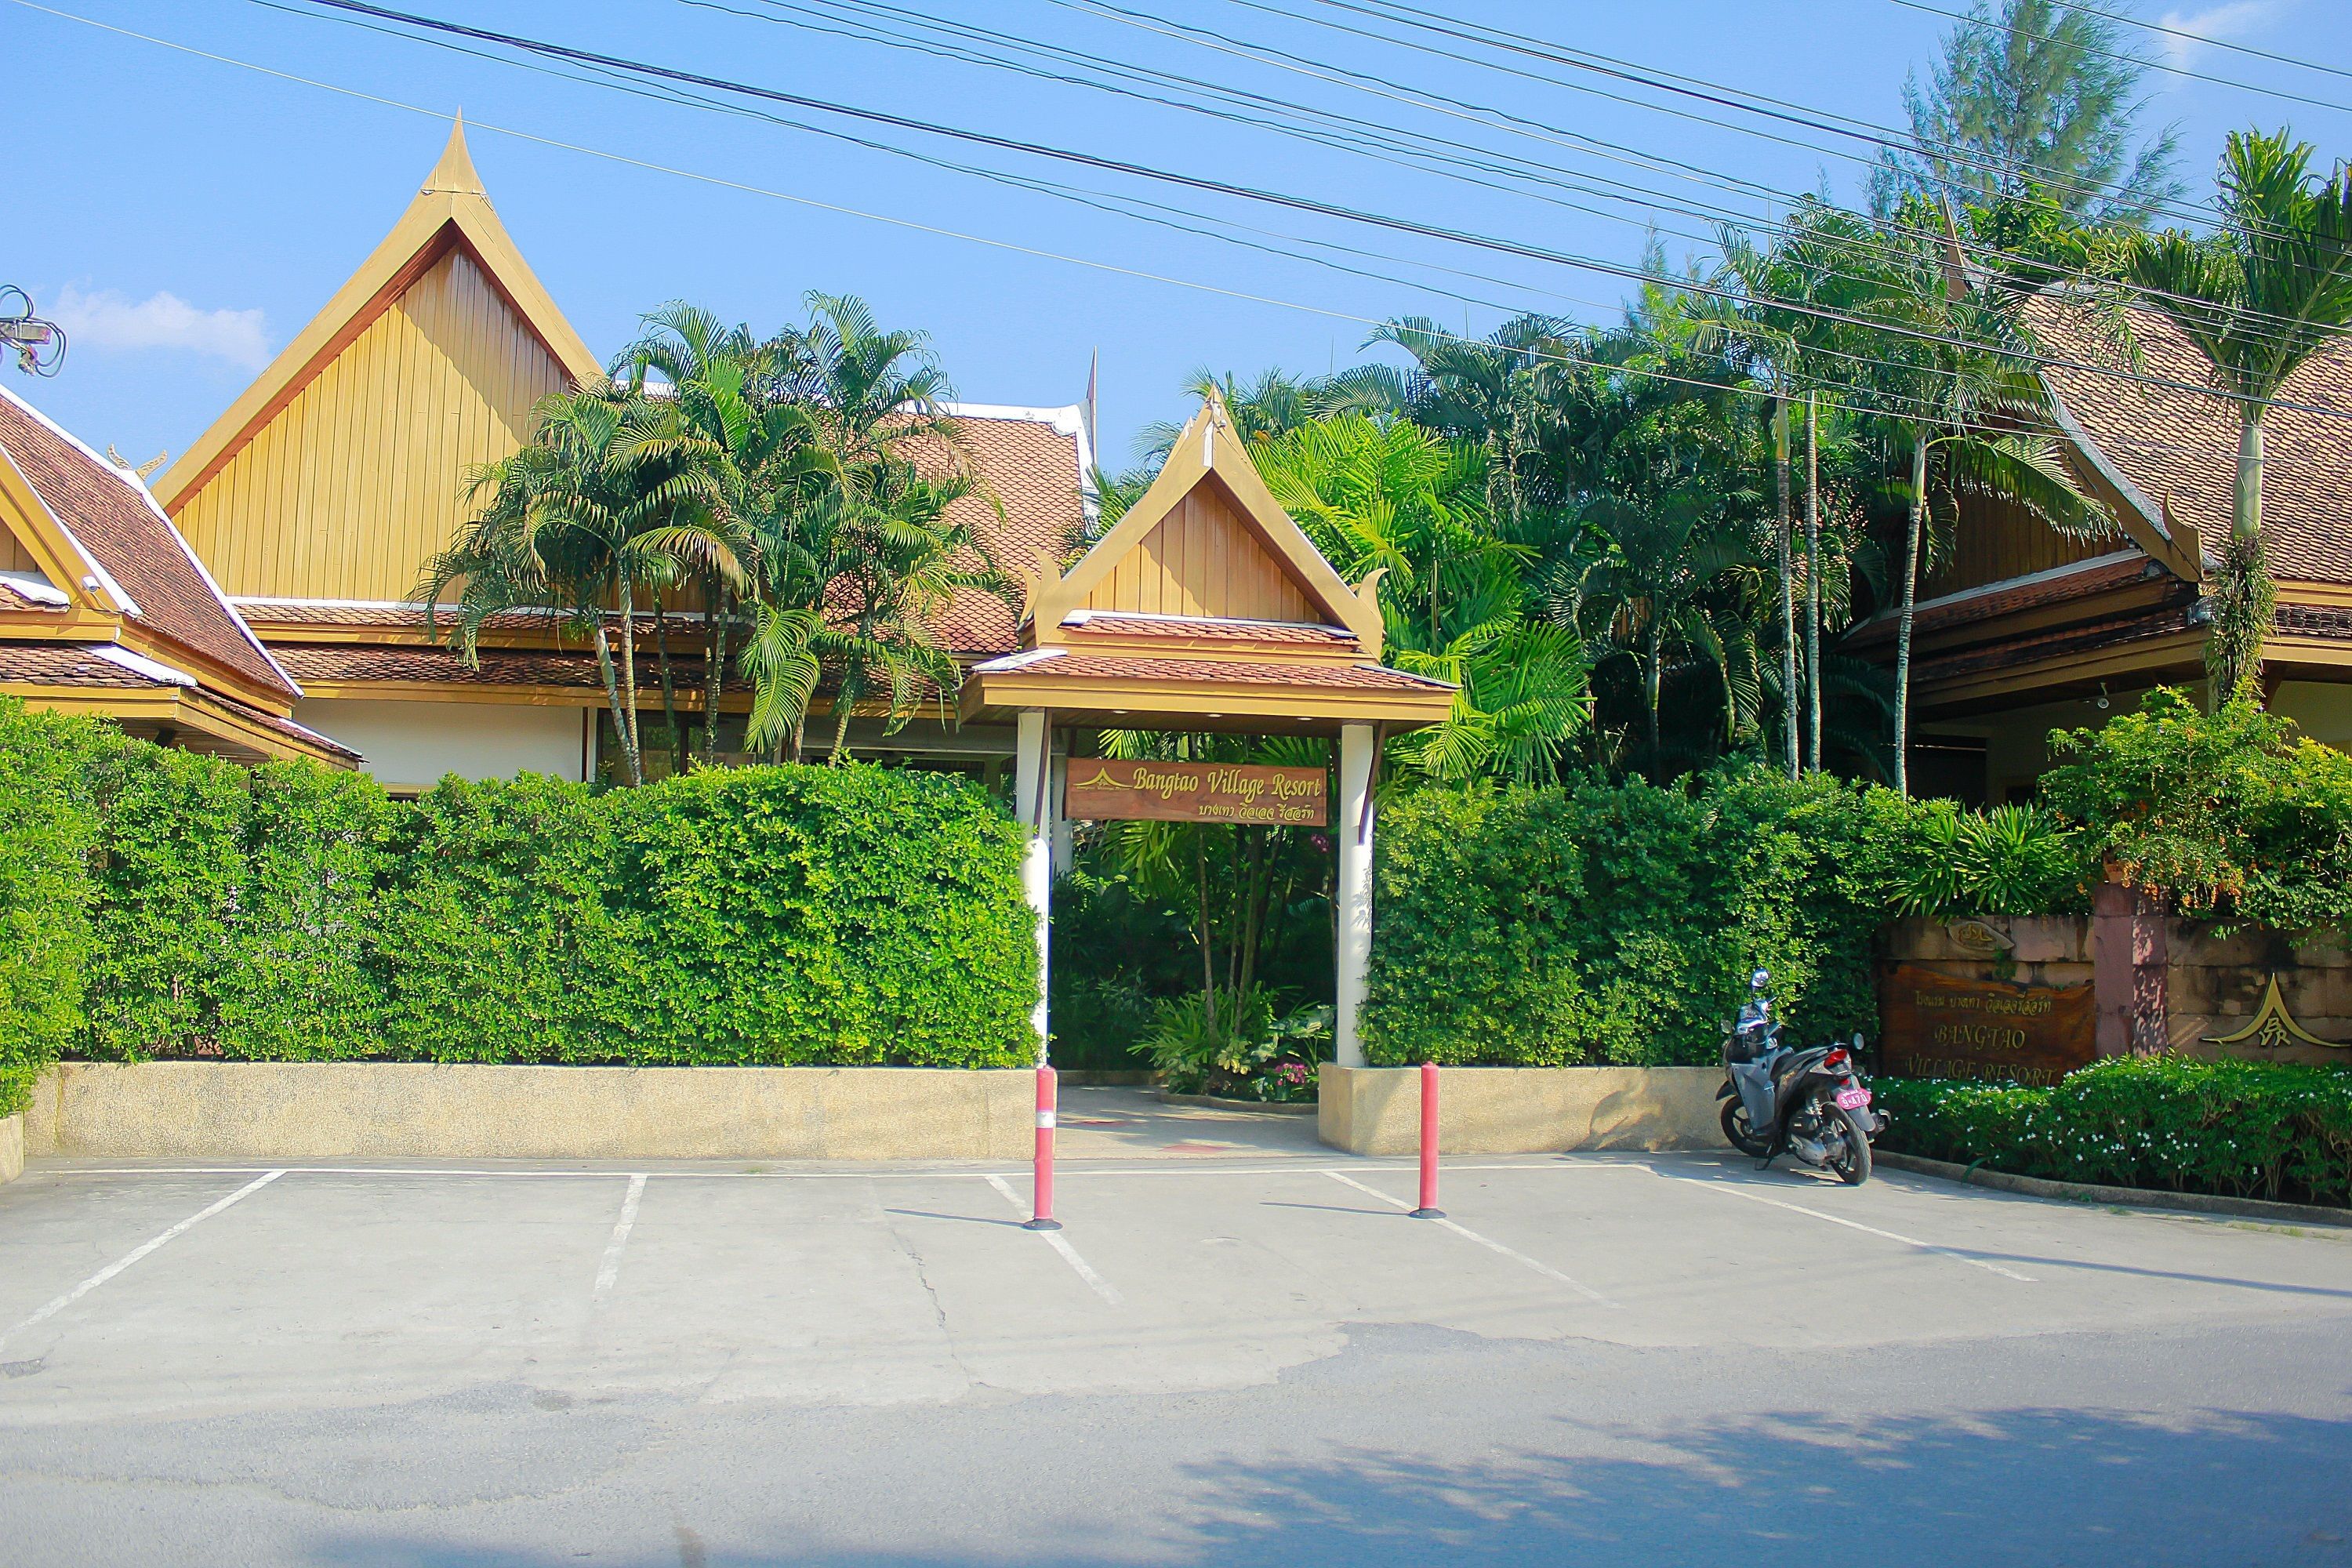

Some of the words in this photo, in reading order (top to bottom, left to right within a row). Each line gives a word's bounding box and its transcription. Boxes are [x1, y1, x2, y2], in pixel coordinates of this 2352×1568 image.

[1133, 767, 1199, 800] Bangtao
[1207, 768, 1265, 804] Village
[1271, 773, 1321, 800] Resort
[1199, 804, 1235, 817] บางเทา
[1934, 1024, 2026, 1051] BANGTAO
[1906, 1053, 1976, 1080] VILLAGE
[1982, 1063, 2058, 1087] RESORT
